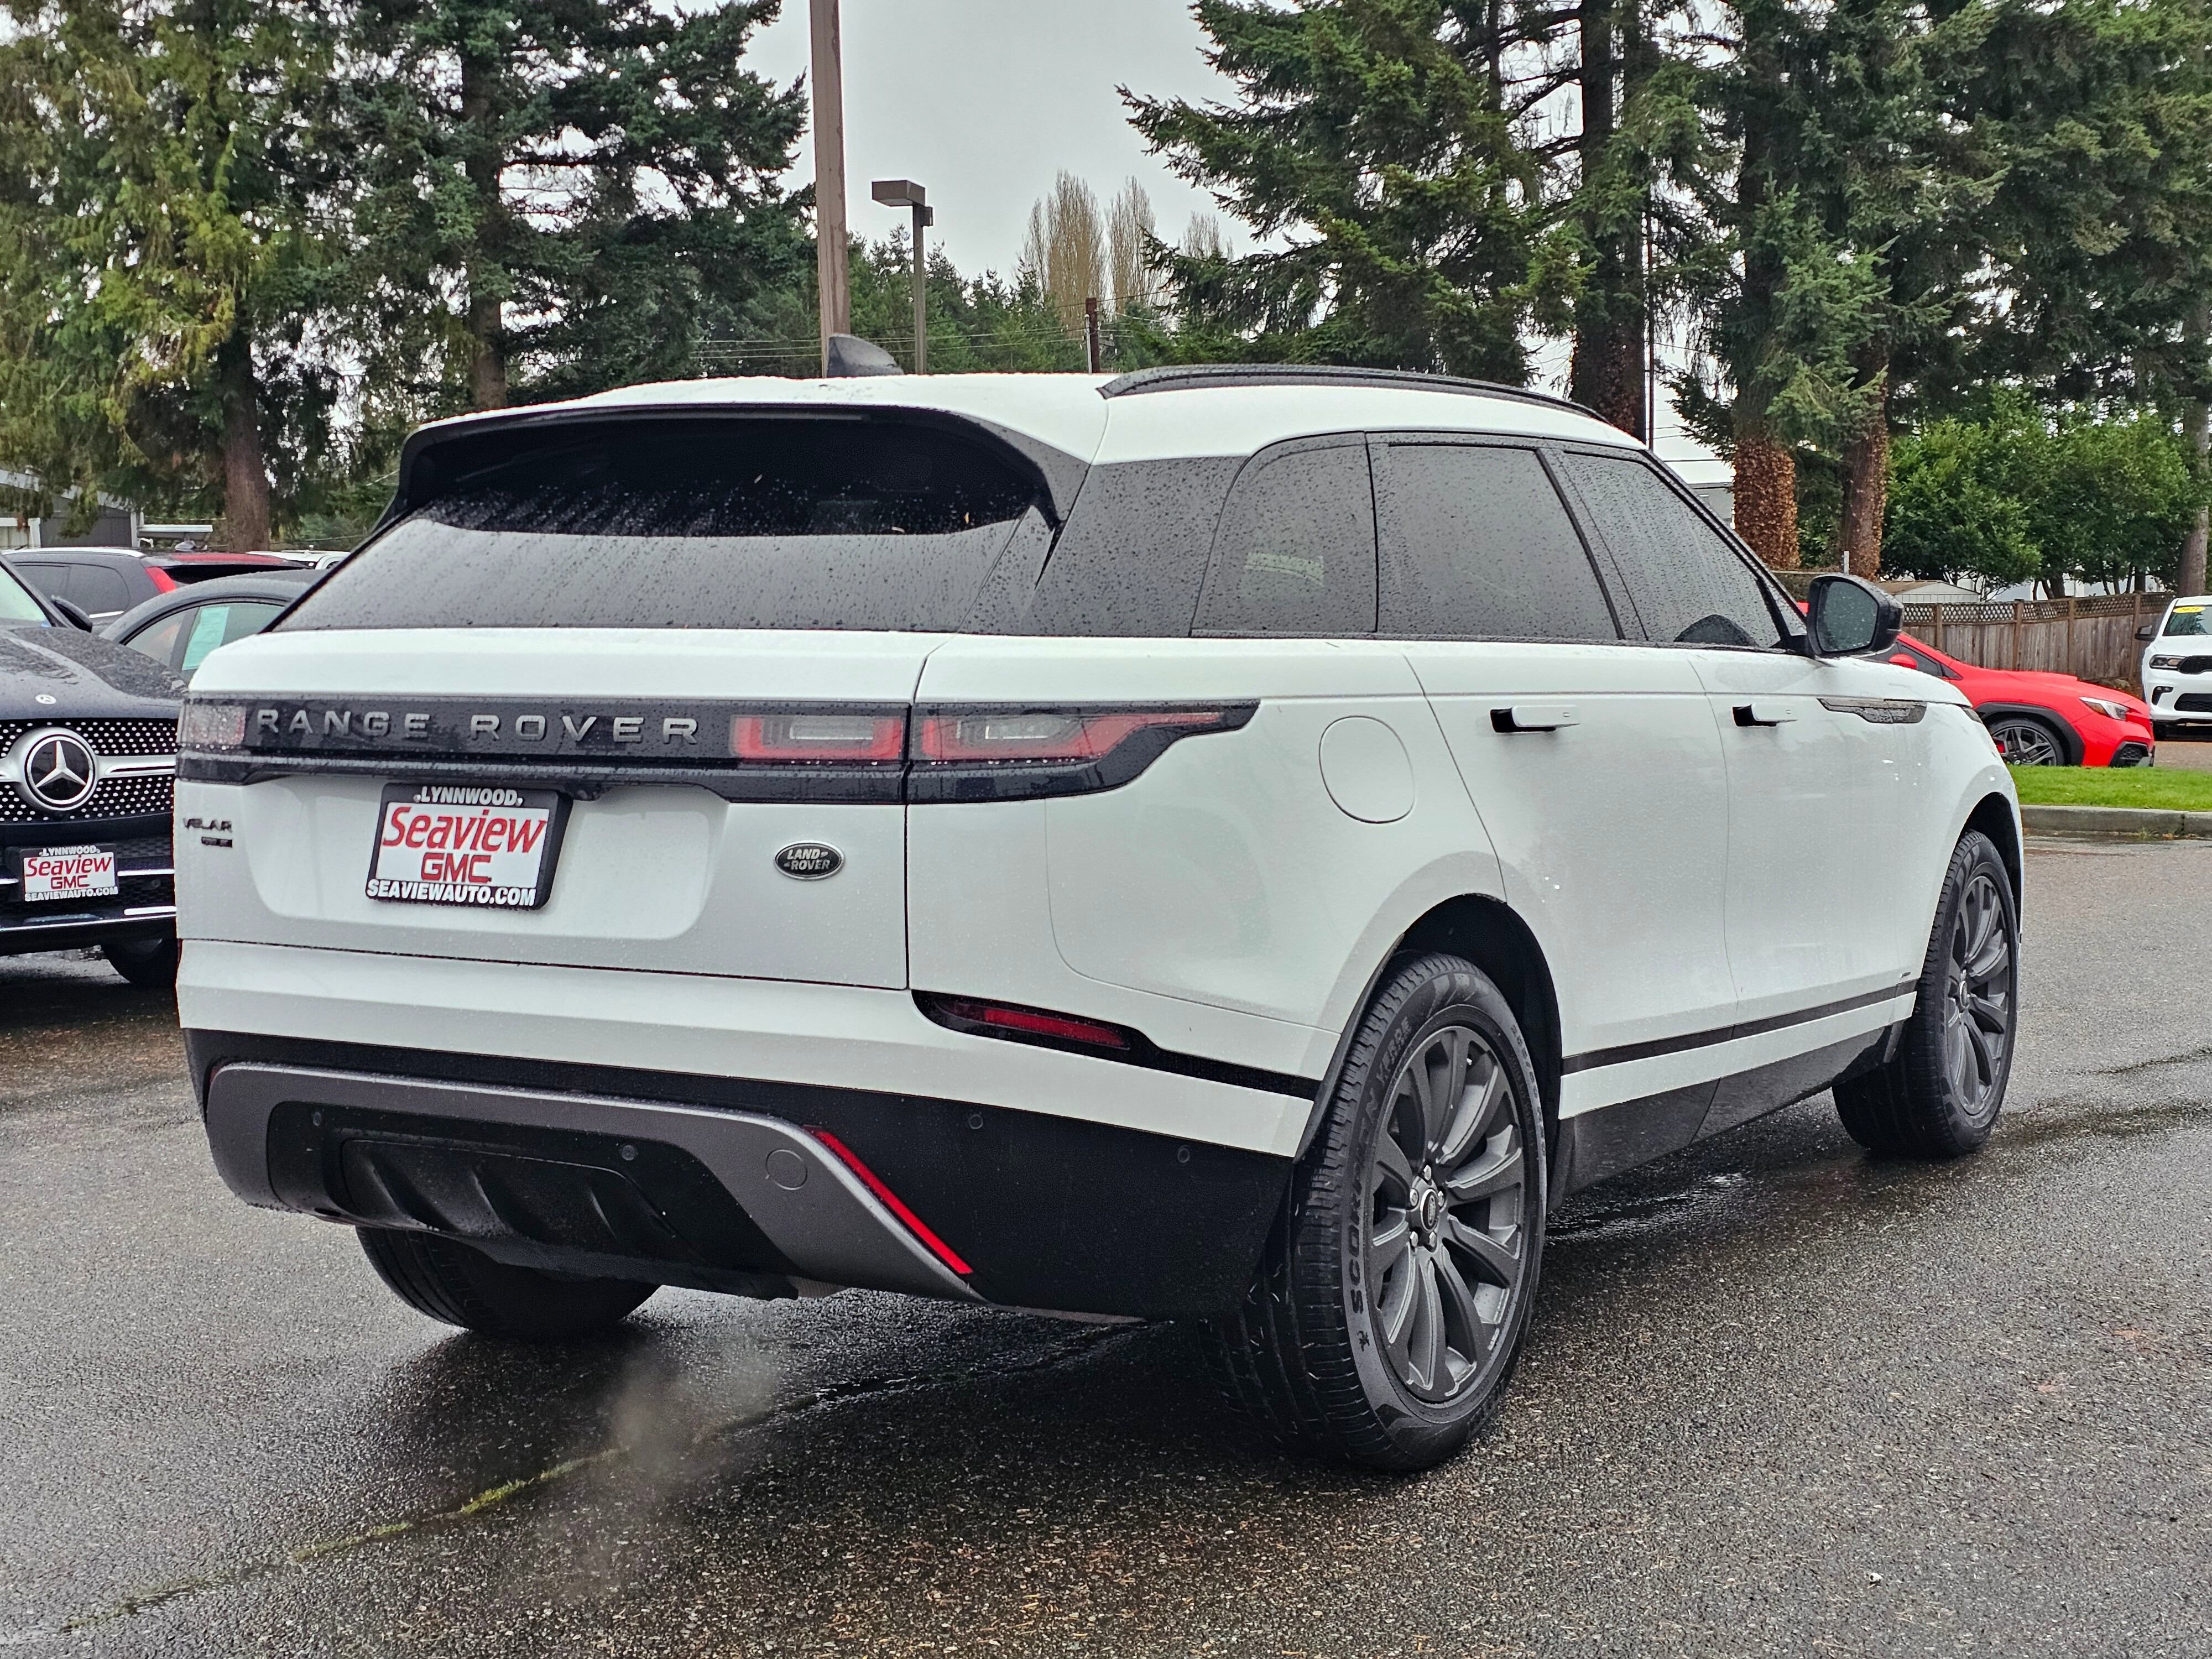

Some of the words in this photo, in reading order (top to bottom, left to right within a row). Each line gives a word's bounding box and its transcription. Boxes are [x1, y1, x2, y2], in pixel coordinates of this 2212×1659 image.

[255, 709, 430, 738] RANGE
[470, 714, 698, 745] ROVER
[421, 786, 518, 806] LYNNWOOD
[182, 818, 233, 833] VELAR
[383, 806, 548, 853] Seaview
[43, 845, 97, 857] LYNNWOOD
[787, 848, 821, 860] LAND
[25, 854, 112, 877] Seaview
[421, 852, 492, 883] GMC
[791, 859, 831, 870] ROVER
[50, 875, 90, 890] GMC
[24, 886, 118, 901] SEAVIEWAUTO.COM
[367, 879, 536, 906] SEAVIEWAUTO.COM
